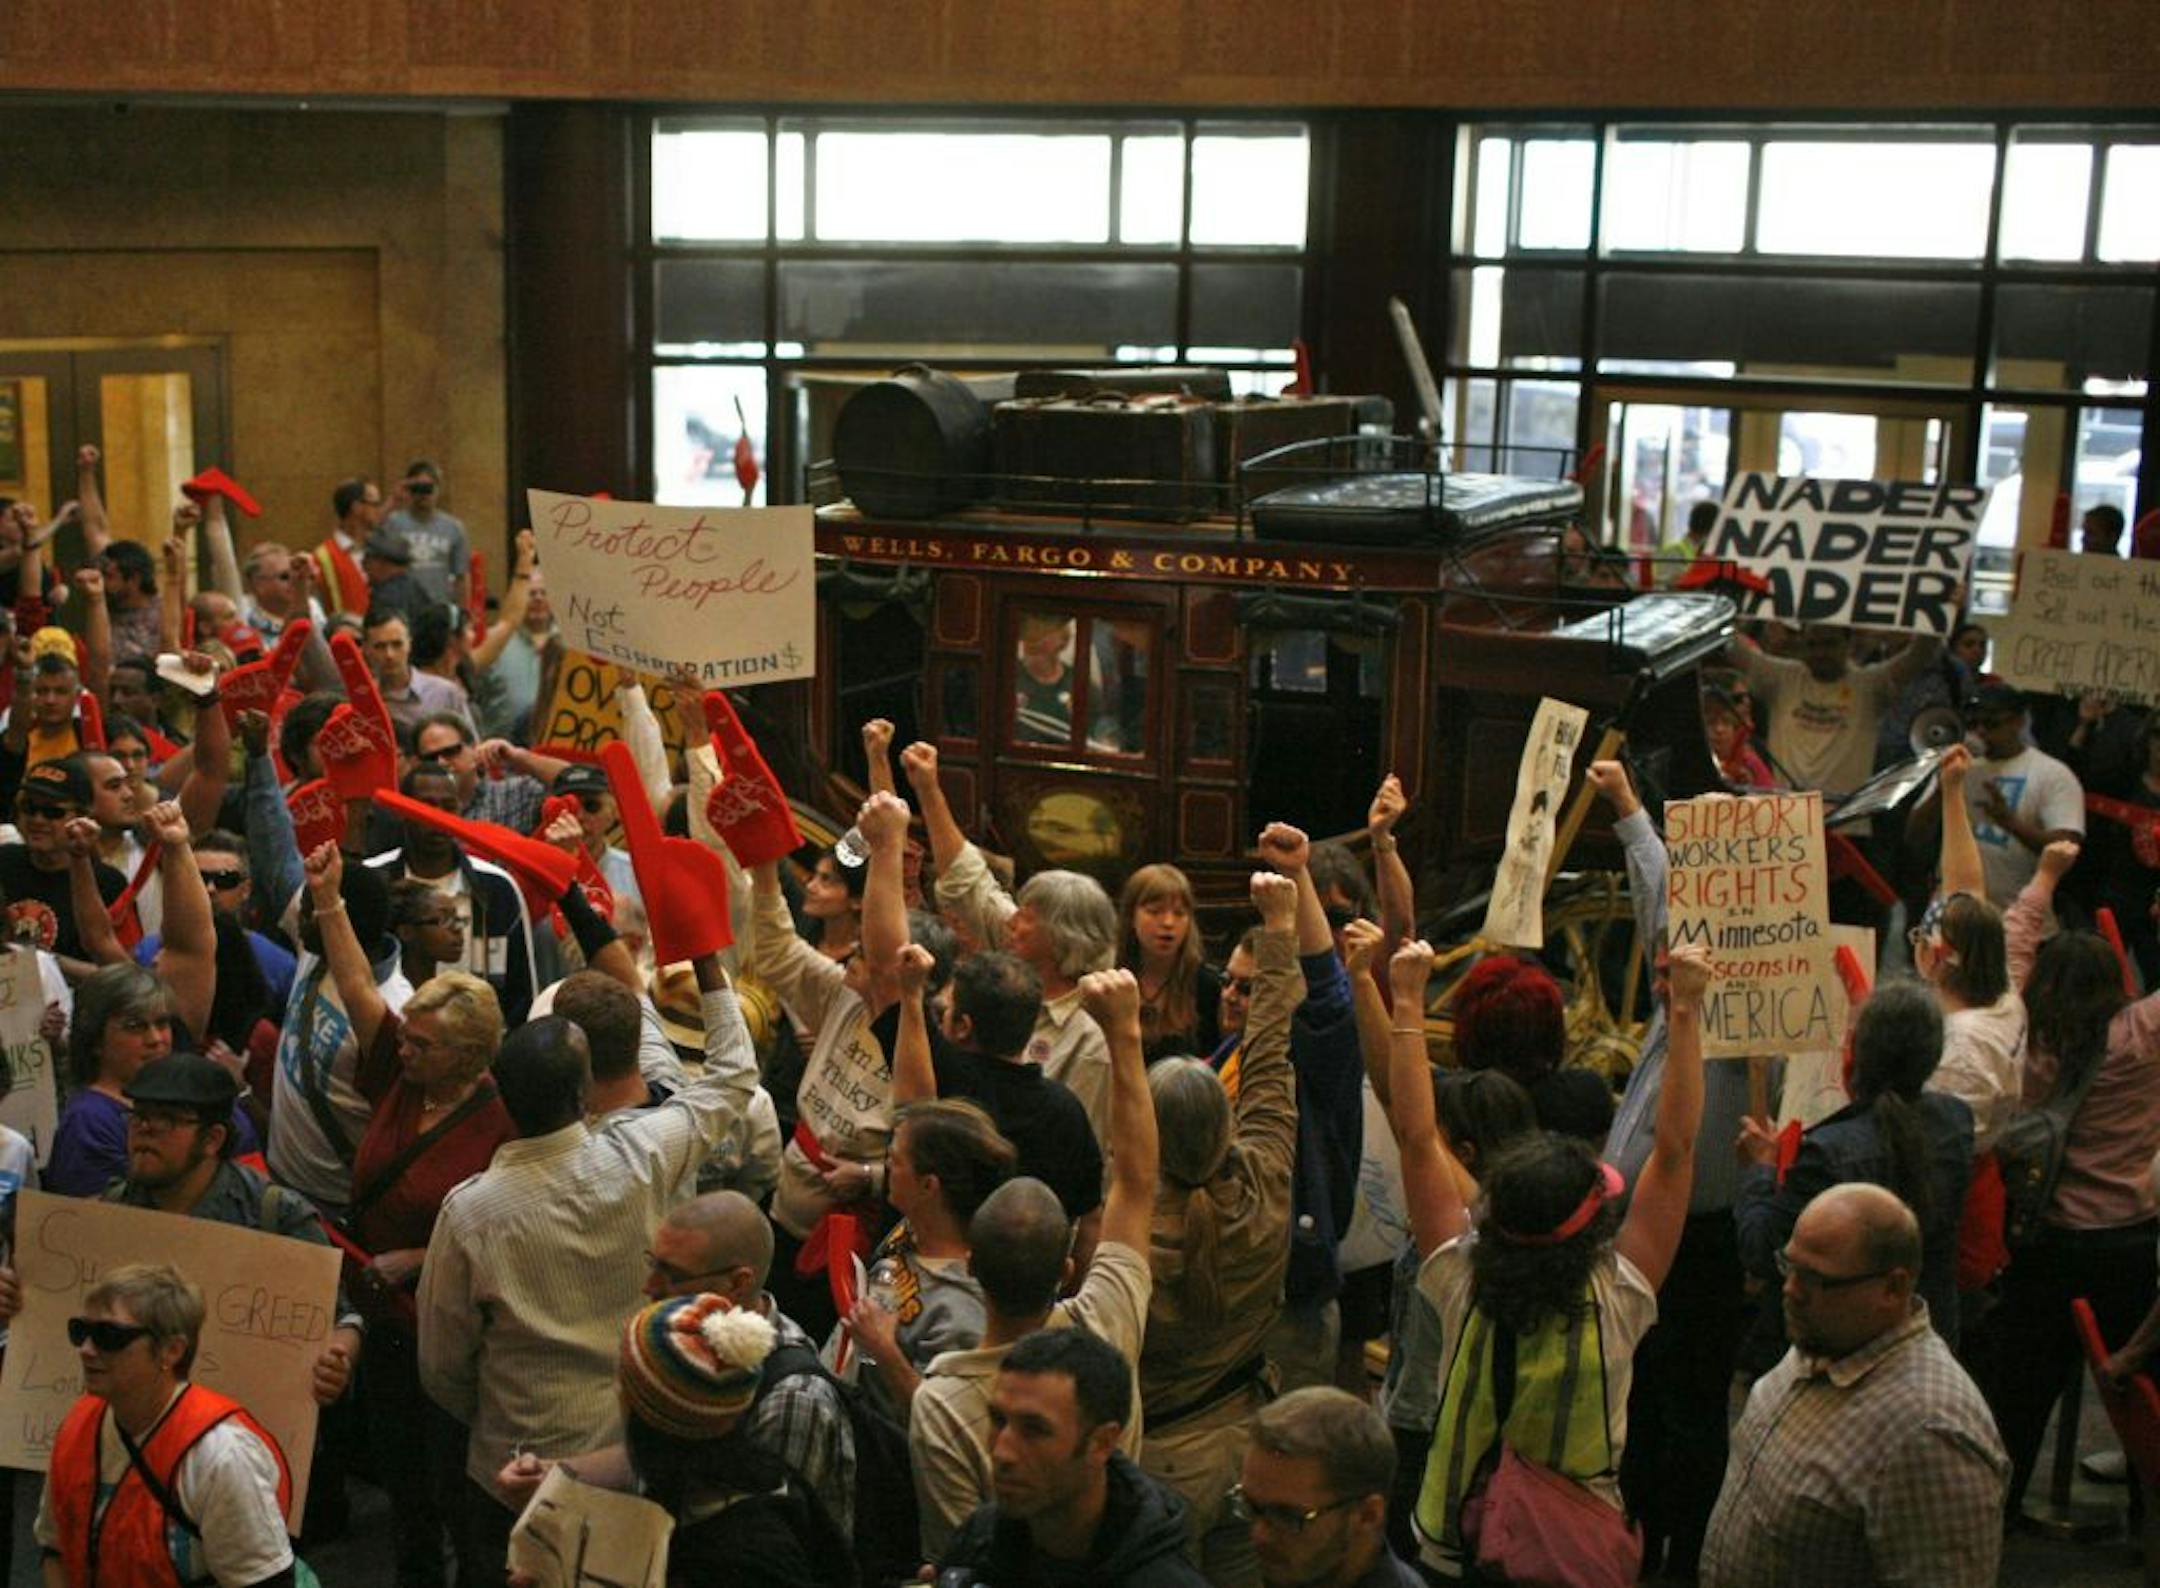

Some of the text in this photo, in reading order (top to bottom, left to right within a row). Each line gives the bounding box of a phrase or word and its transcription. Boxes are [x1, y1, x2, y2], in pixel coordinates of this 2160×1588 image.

[1733, 473, 1984, 521] NADER
[549, 500, 720, 563] Protect
[973, 543, 1092, 567] FARGO
[1110, 551, 1134, 569] &
[1716, 517, 1971, 569] NADER
[631, 558, 799, 610] People
[1743, 567, 1957, 633] ADER
[569, 595, 626, 634] Not
[567, 665, 677, 740] OVR
[1665, 794, 1820, 844] SUPPORT
[1668, 835, 1807, 868] WORKERS
[1668, 863, 1812, 908] RIGHTS
[1670, 911, 1821, 949] Minnesota
[1701, 984, 1833, 1041] MERICA
[216, 1284, 328, 1342] GREED
